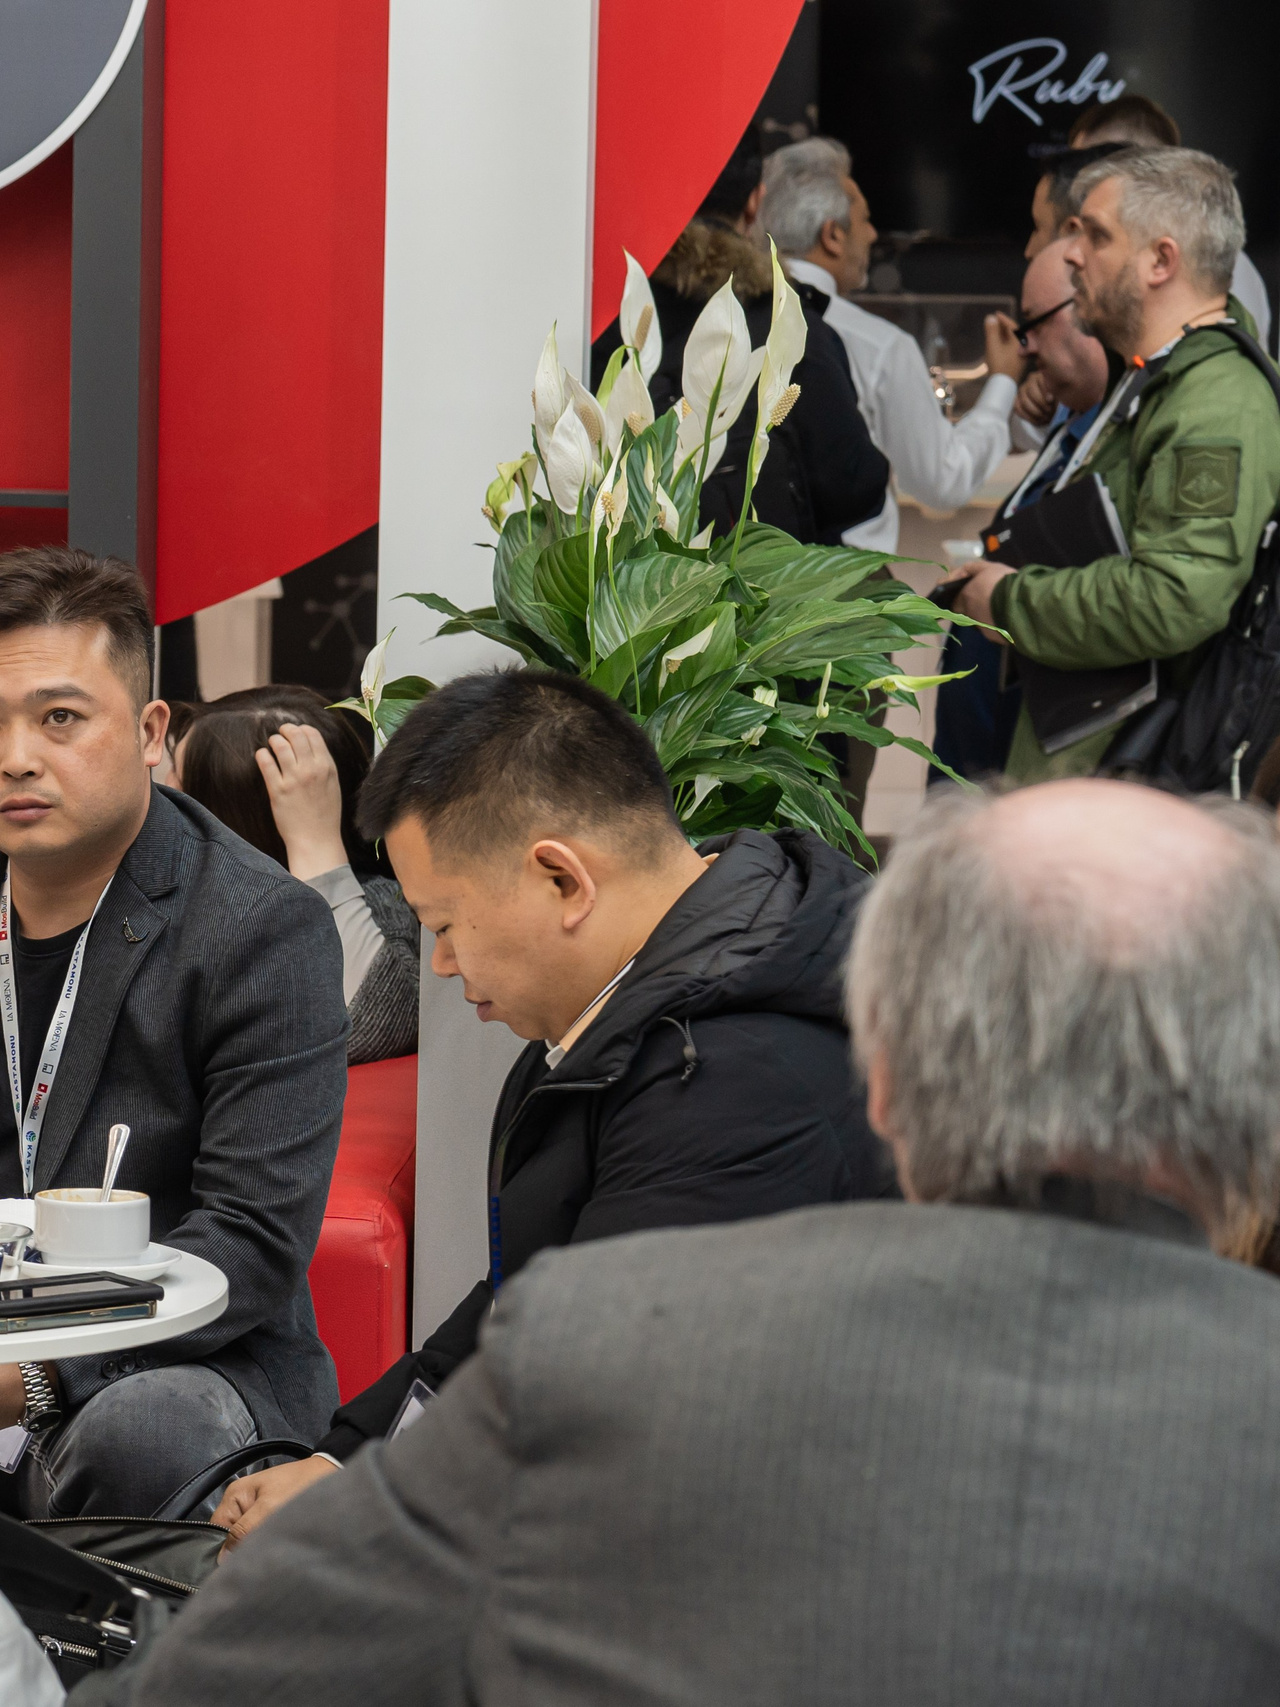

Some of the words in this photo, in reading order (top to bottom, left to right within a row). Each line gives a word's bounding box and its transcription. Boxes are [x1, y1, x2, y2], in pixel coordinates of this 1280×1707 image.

[65, 936, 84, 999] KASTAMONU
[3, 978, 12, 1011] MOENA
[49, 1021, 64, 1052] MOENA
[9, 1035, 20, 1100] KASTAMONU
[29, 1093, 43, 1120] MosBuild
